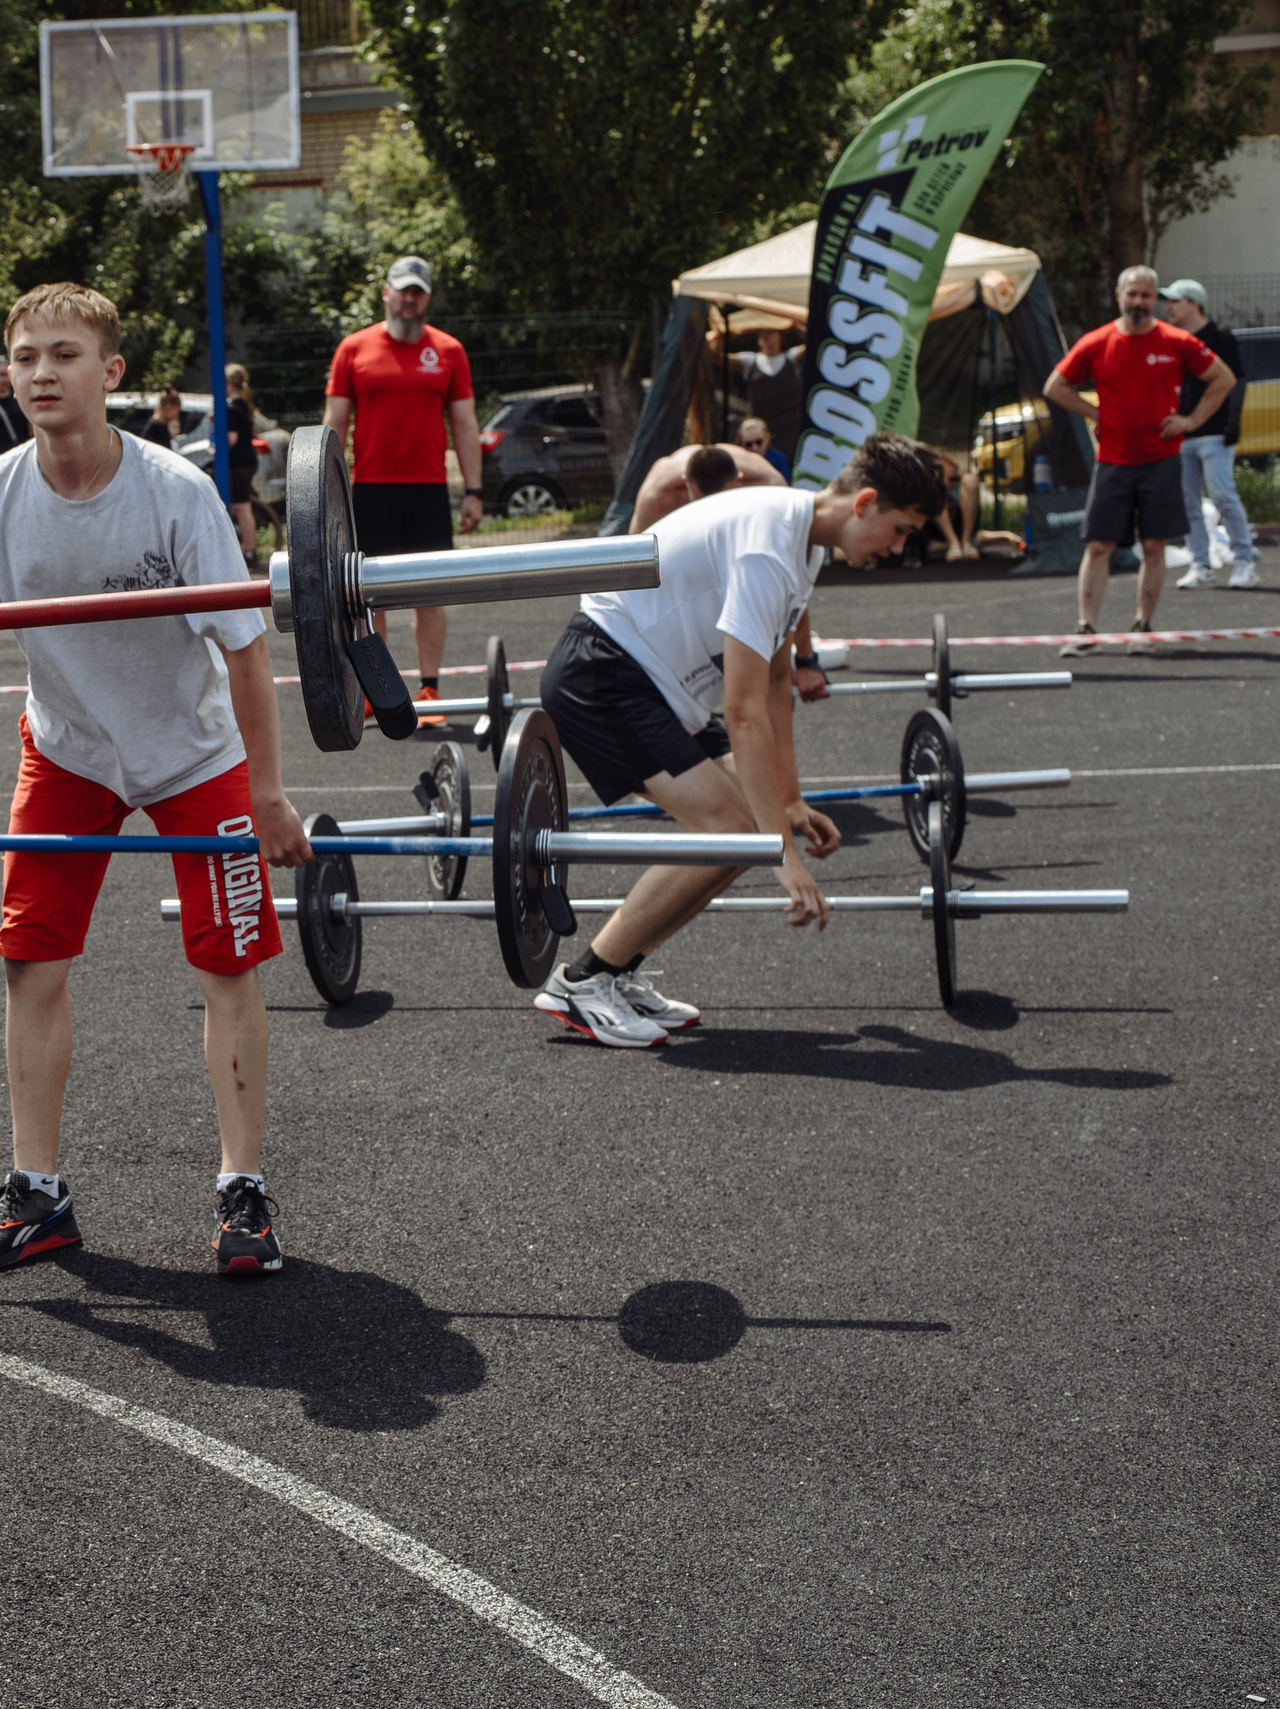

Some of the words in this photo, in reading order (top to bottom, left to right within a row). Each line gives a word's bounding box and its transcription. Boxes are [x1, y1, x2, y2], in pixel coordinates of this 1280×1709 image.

[902, 130, 990, 164] Petrov
[792, 191, 941, 493] ROSSFIT
[206, 855, 214, 864] DO
[208, 864, 217, 880] WHAT
[210, 881, 218, 894] YOU
[212, 894, 221, 917] REALLY
